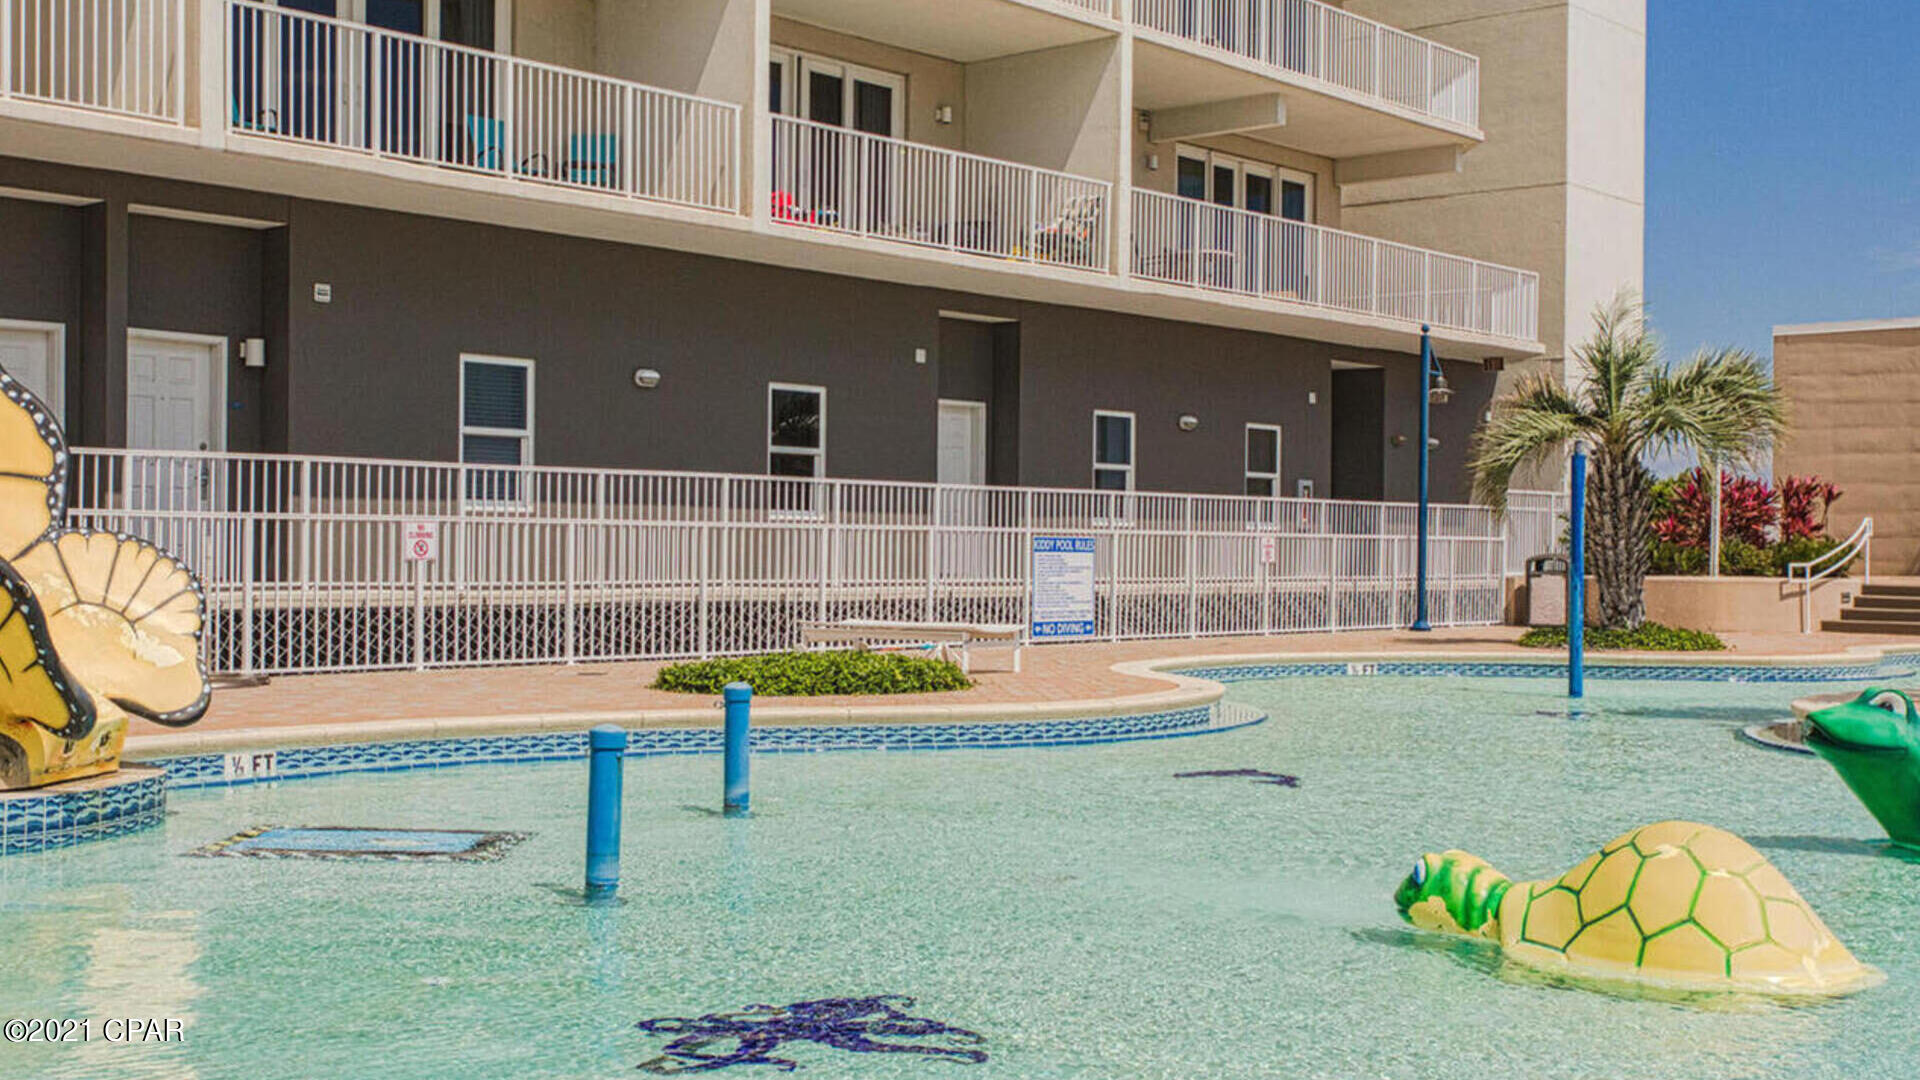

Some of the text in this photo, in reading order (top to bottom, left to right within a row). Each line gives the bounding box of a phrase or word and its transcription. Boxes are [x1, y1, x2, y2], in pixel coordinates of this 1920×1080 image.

[1056, 540, 1073, 550] POOL
[1075, 539, 1095, 550] RULES
[1042, 623, 1084, 634] NO DIVING
[252, 754, 274, 771] FT
